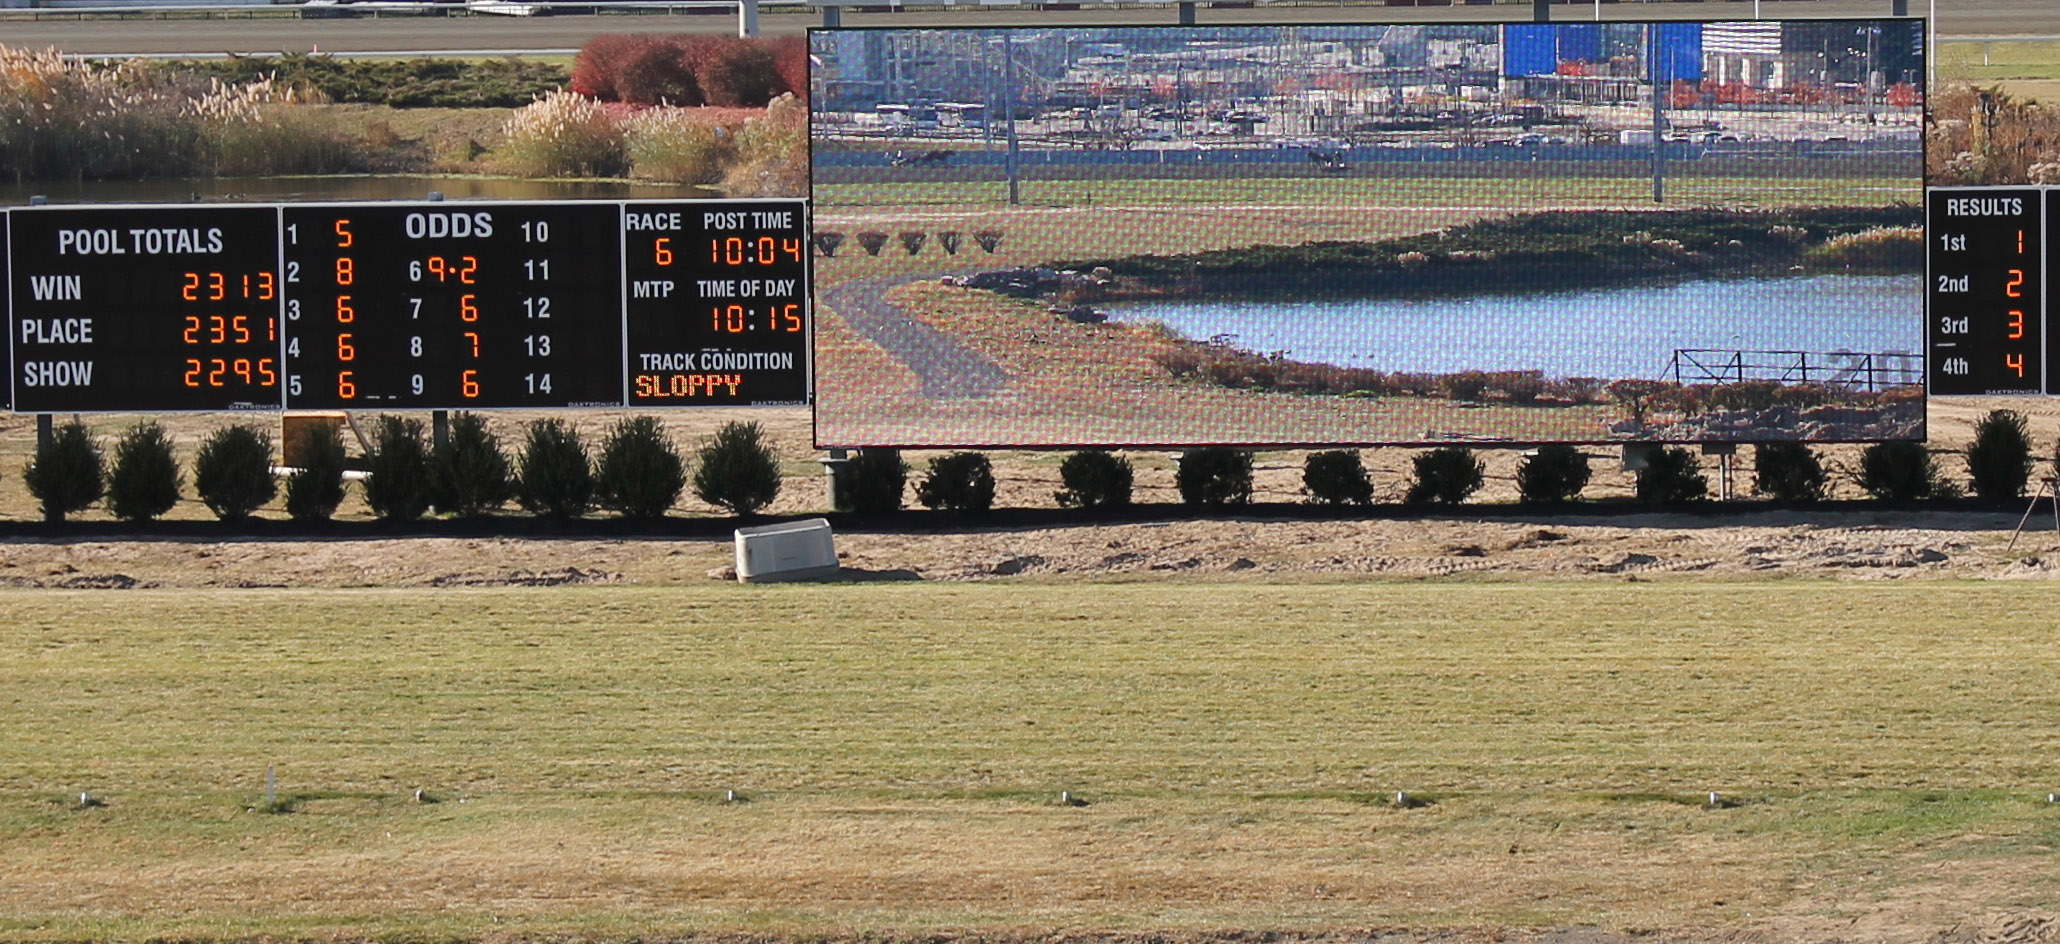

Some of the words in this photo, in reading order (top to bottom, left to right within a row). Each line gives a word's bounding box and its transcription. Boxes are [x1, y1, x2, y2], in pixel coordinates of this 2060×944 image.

[1947, 198, 2023, 216] RESULTS
[288, 223, 297, 245] 1
[336, 219, 353, 248] 5
[405, 212, 493, 239] ODDS
[521, 221, 549, 243] 10
[626, 213, 682, 231] RACE
[704, 212, 747, 230] POST
[751, 212, 793, 229] TIME
[58, 228, 126, 255] POOL
[130, 227, 223, 254] TOTALS
[655, 237, 673, 266] 6
[712, 236, 800, 266] 10:04
[1940, 233, 1966, 251] 1st
[2017, 229, 2023, 254] 1
[287, 261, 300, 283] 2
[336, 257, 354, 286] 8
[409, 260, 422, 282] 6
[524, 259, 549, 281] 11
[1938, 275, 1969, 293] 2nd
[2006, 268, 2023, 298] 2
[31, 275, 82, 301] WIN
[183, 271, 274, 302] 2313
[633, 280, 675, 298] MTP
[697, 280, 736, 297] TIME
[740, 279, 761, 297] OF
[765, 279, 796, 297] DAY
[288, 299, 301, 321] 3
[337, 294, 355, 324] 6
[409, 298, 422, 319] 7
[461, 293, 479, 323] 6
[523, 297, 551, 319] 12
[713, 303, 801, 333] 10:15
[21, 318, 93, 344] PLACE
[183, 315, 275, 344] 2351
[1941, 316, 1969, 334] 3rd
[2008, 309, 2024, 339] 3
[287, 336, 301, 358] 4
[338, 332, 355, 362] 6
[410, 335, 423, 357] 8
[463, 331, 479, 358] 7
[524, 334, 551, 357] 13
[24, 360, 93, 387] SHOW
[184, 357, 276, 388] 2295
[640, 353, 696, 371] TRACK
[701, 352, 793, 370] CONDITION
[1942, 357, 1969, 375] 4th
[2006, 353, 2023, 378] 4
[290, 374, 302, 396] 5
[338, 370, 356, 400] 6
[411, 374, 424, 395] 9
[462, 369, 480, 398] 6
[524, 373, 552, 394] 14
[635, 374, 741, 397] SLOPPY
